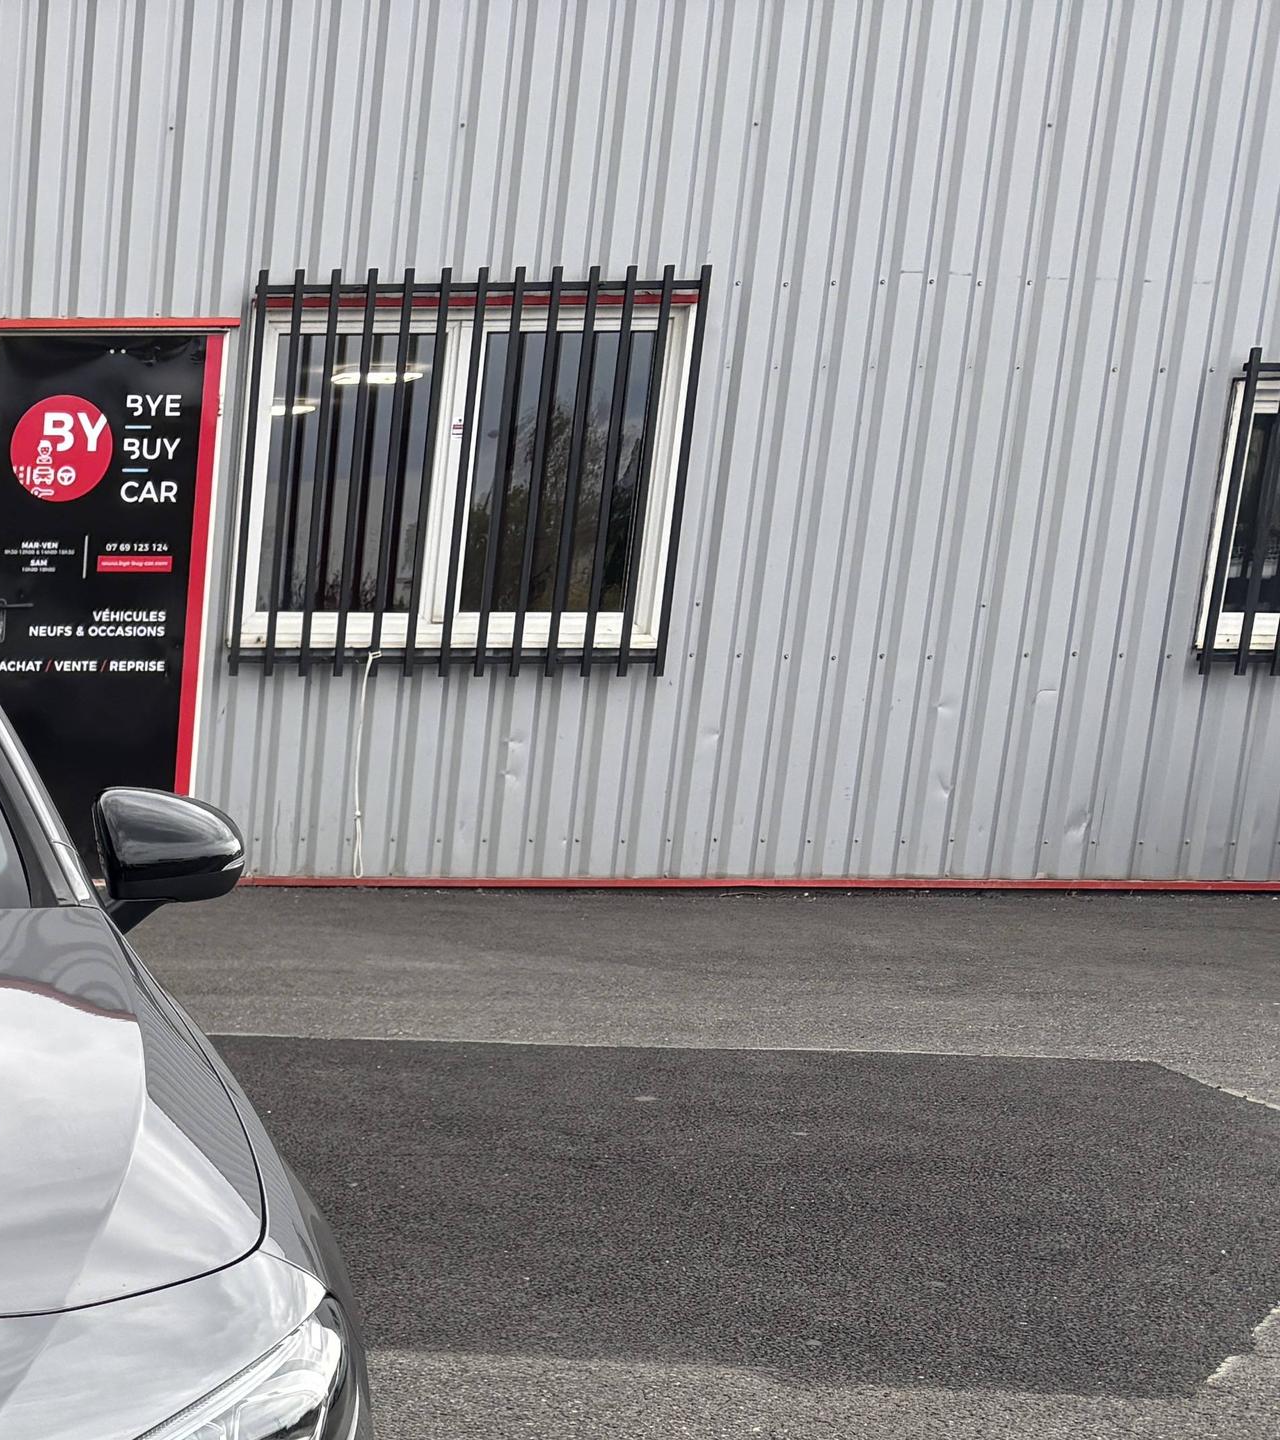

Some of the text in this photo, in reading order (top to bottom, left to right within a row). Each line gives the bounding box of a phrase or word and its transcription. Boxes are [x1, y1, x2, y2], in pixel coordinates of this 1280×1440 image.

[126, 394, 182, 417] BYE
[43, 411, 108, 452] BY
[123, 437, 181, 460] BUY
[120, 480, 178, 503] CAR
[105, 543, 118, 552] 07
[93, 608, 166, 622] VÉHICULES
[28, 625, 166, 637] NEUFS & OCCASIONS
[54, 660, 98, 672] VENTE
[109, 660, 166, 672] REPRISE
